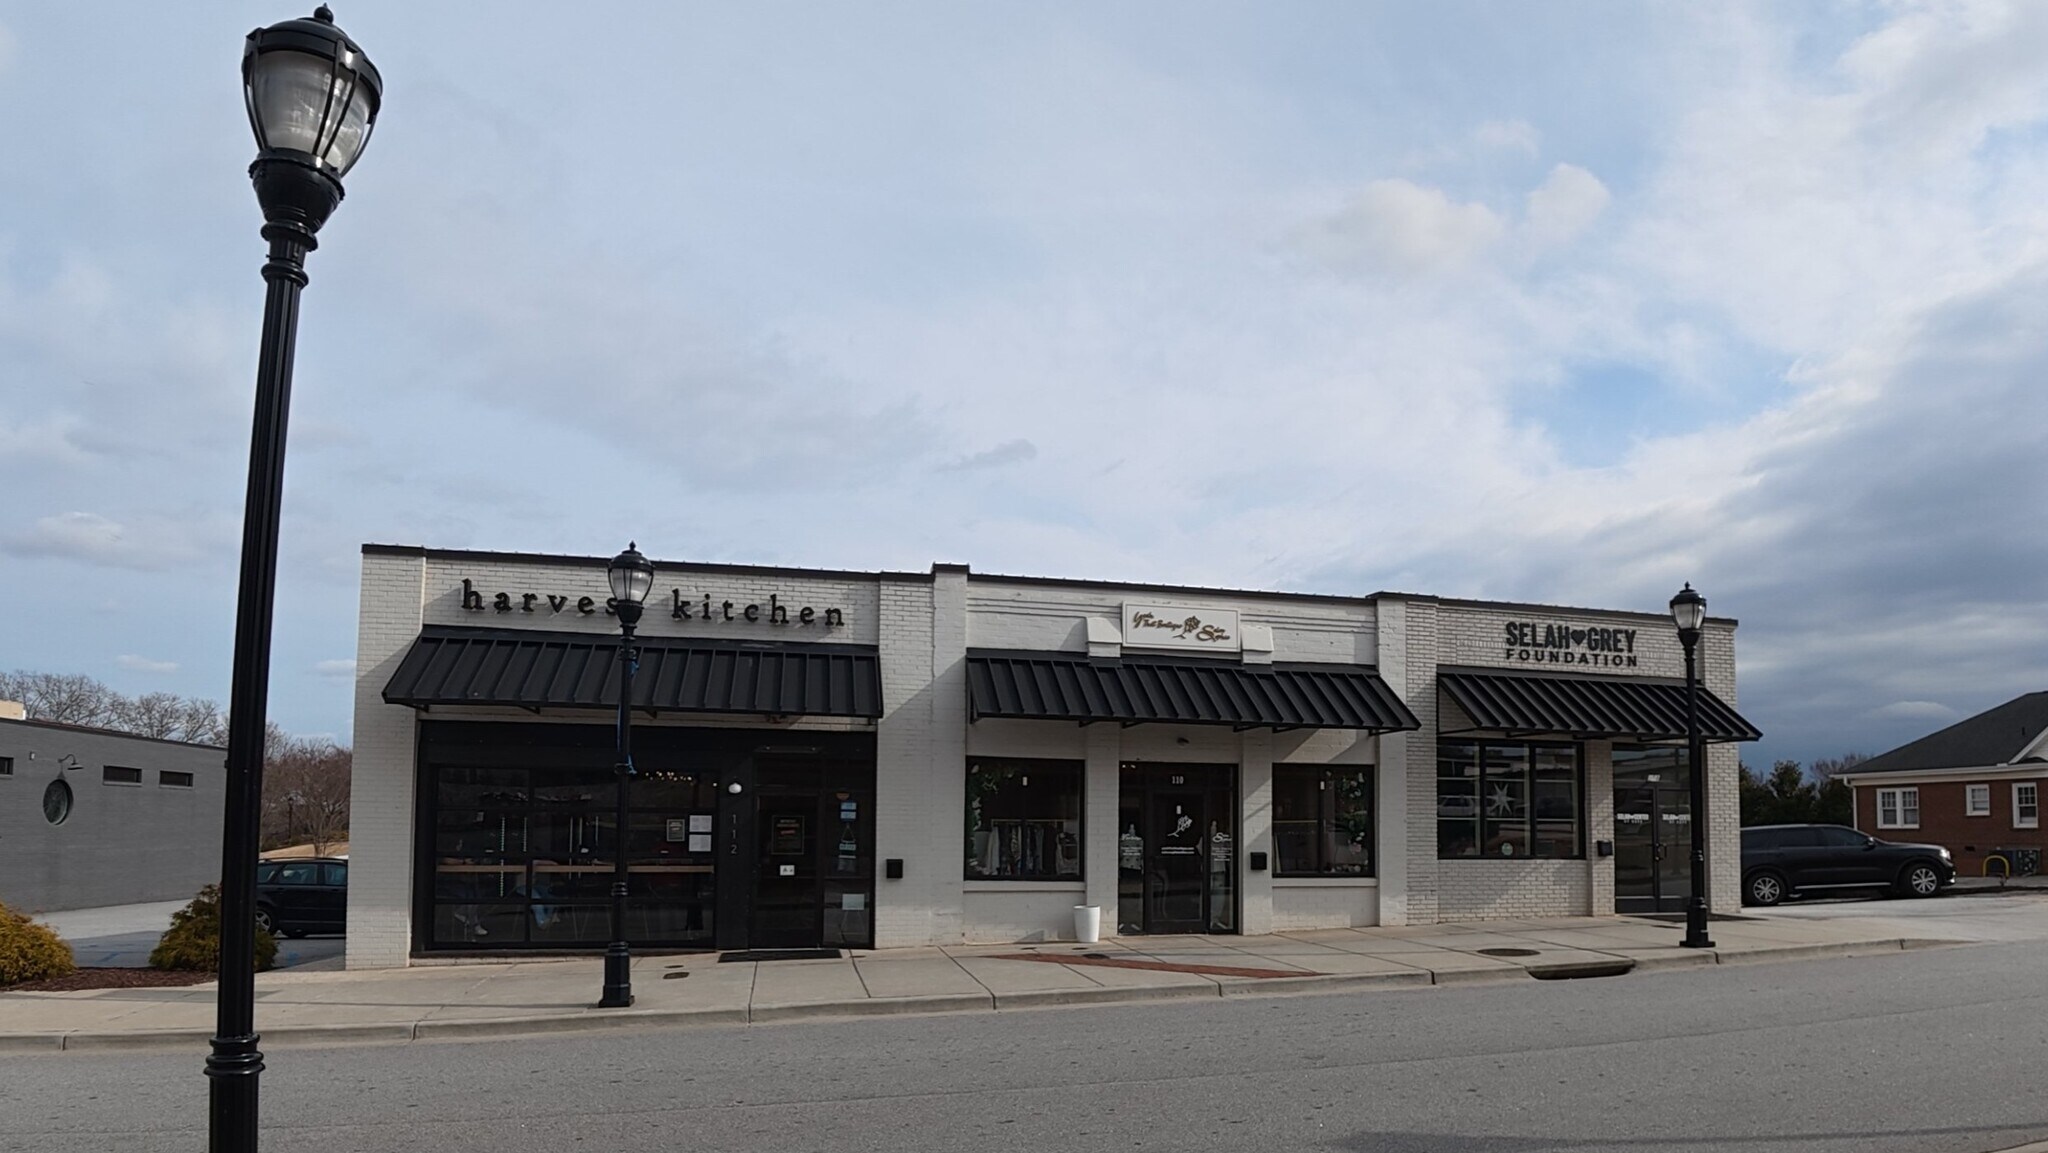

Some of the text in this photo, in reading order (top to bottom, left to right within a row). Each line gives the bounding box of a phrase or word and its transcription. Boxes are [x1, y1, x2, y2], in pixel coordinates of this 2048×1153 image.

[461, 578, 845, 627] harves kitchen
[1505, 621, 1637, 653] SELAH GREY
[1506, 648, 1637, 667] FOUNDATION
[1172, 775, 1184, 784] 110
